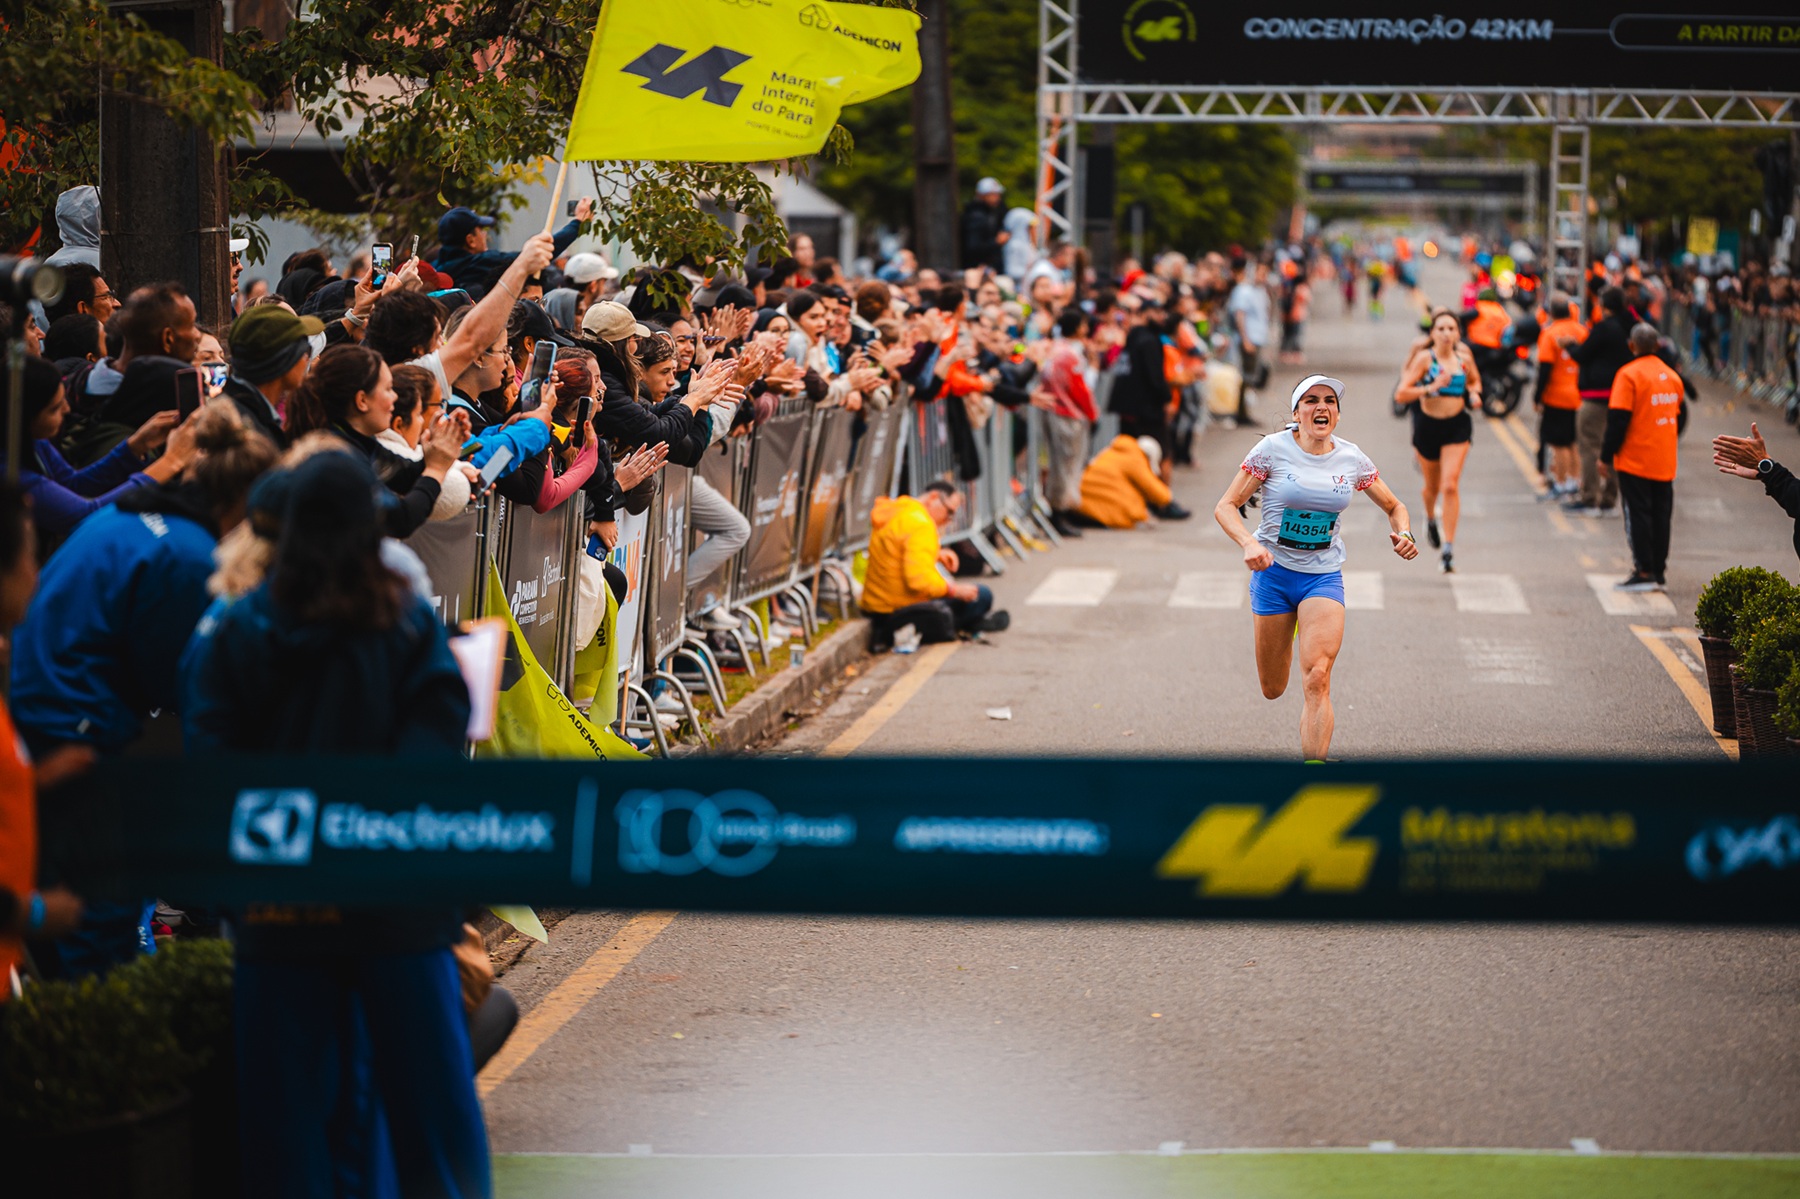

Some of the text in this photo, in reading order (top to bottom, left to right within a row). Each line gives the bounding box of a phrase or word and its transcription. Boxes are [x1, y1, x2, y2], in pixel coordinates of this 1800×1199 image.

[1243, 14, 1554, 45] CONCENTRAÇÃO 42KM
[1678, 24, 1693, 41] A
[1698, 24, 1773, 42] PARTIR
[751, 100, 774, 115] do
[1283, 521, 1328, 537] 14354
[319, 802, 555, 851] Electrolux
